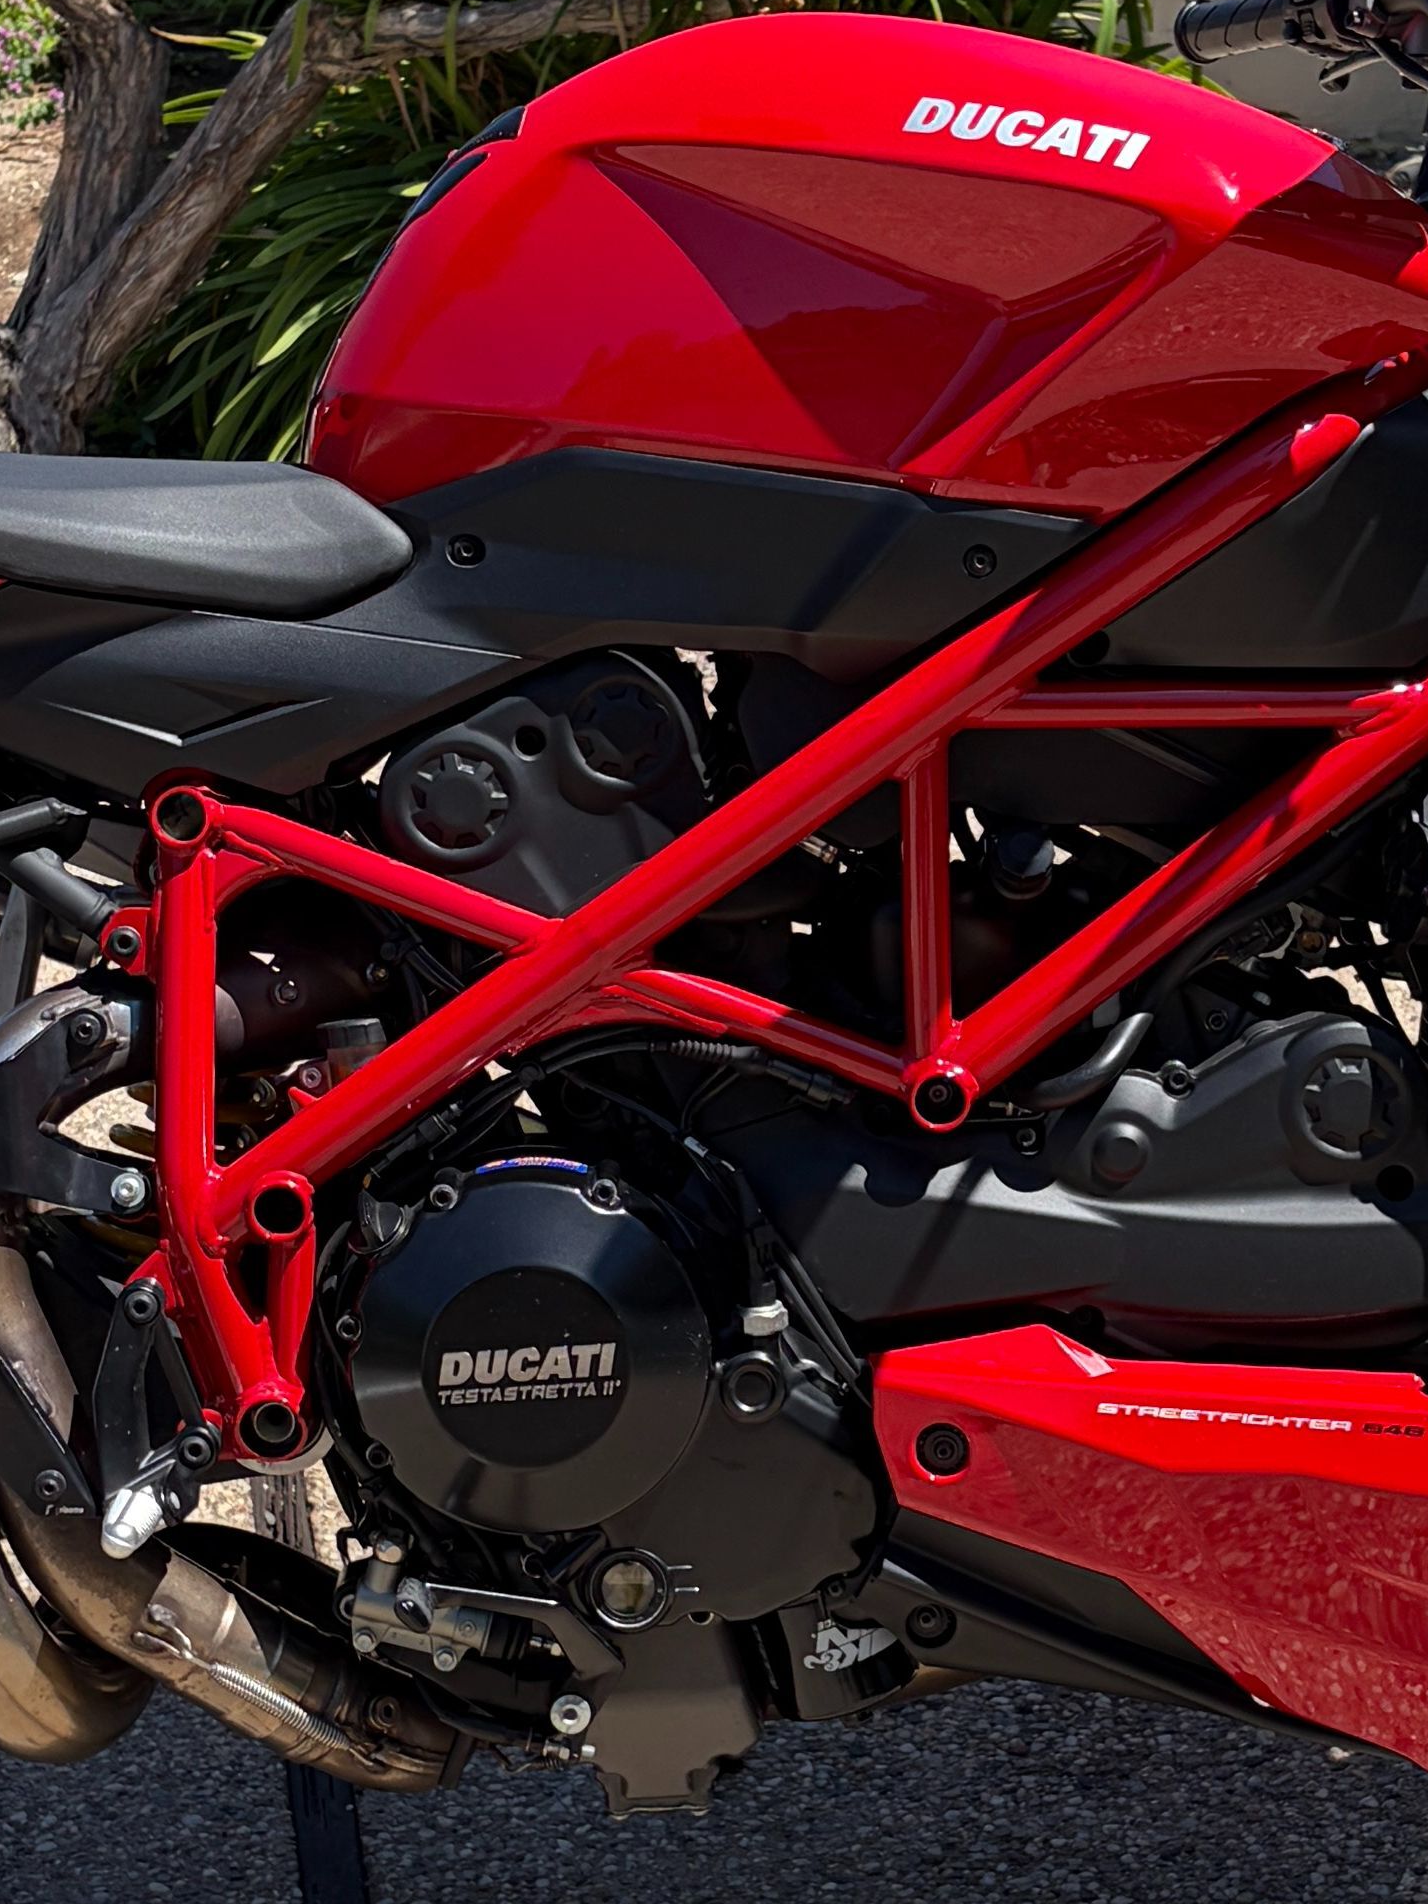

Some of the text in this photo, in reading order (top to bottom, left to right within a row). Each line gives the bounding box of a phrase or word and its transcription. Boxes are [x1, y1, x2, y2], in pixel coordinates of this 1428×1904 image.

[902, 97, 1152, 170] DUCATI
[438, 1343, 617, 1386] DUCATI
[438, 1382, 597, 1406] TESTASTRETTA
[1096, 1402, 1426, 1438] STREETFIGHTER 848
